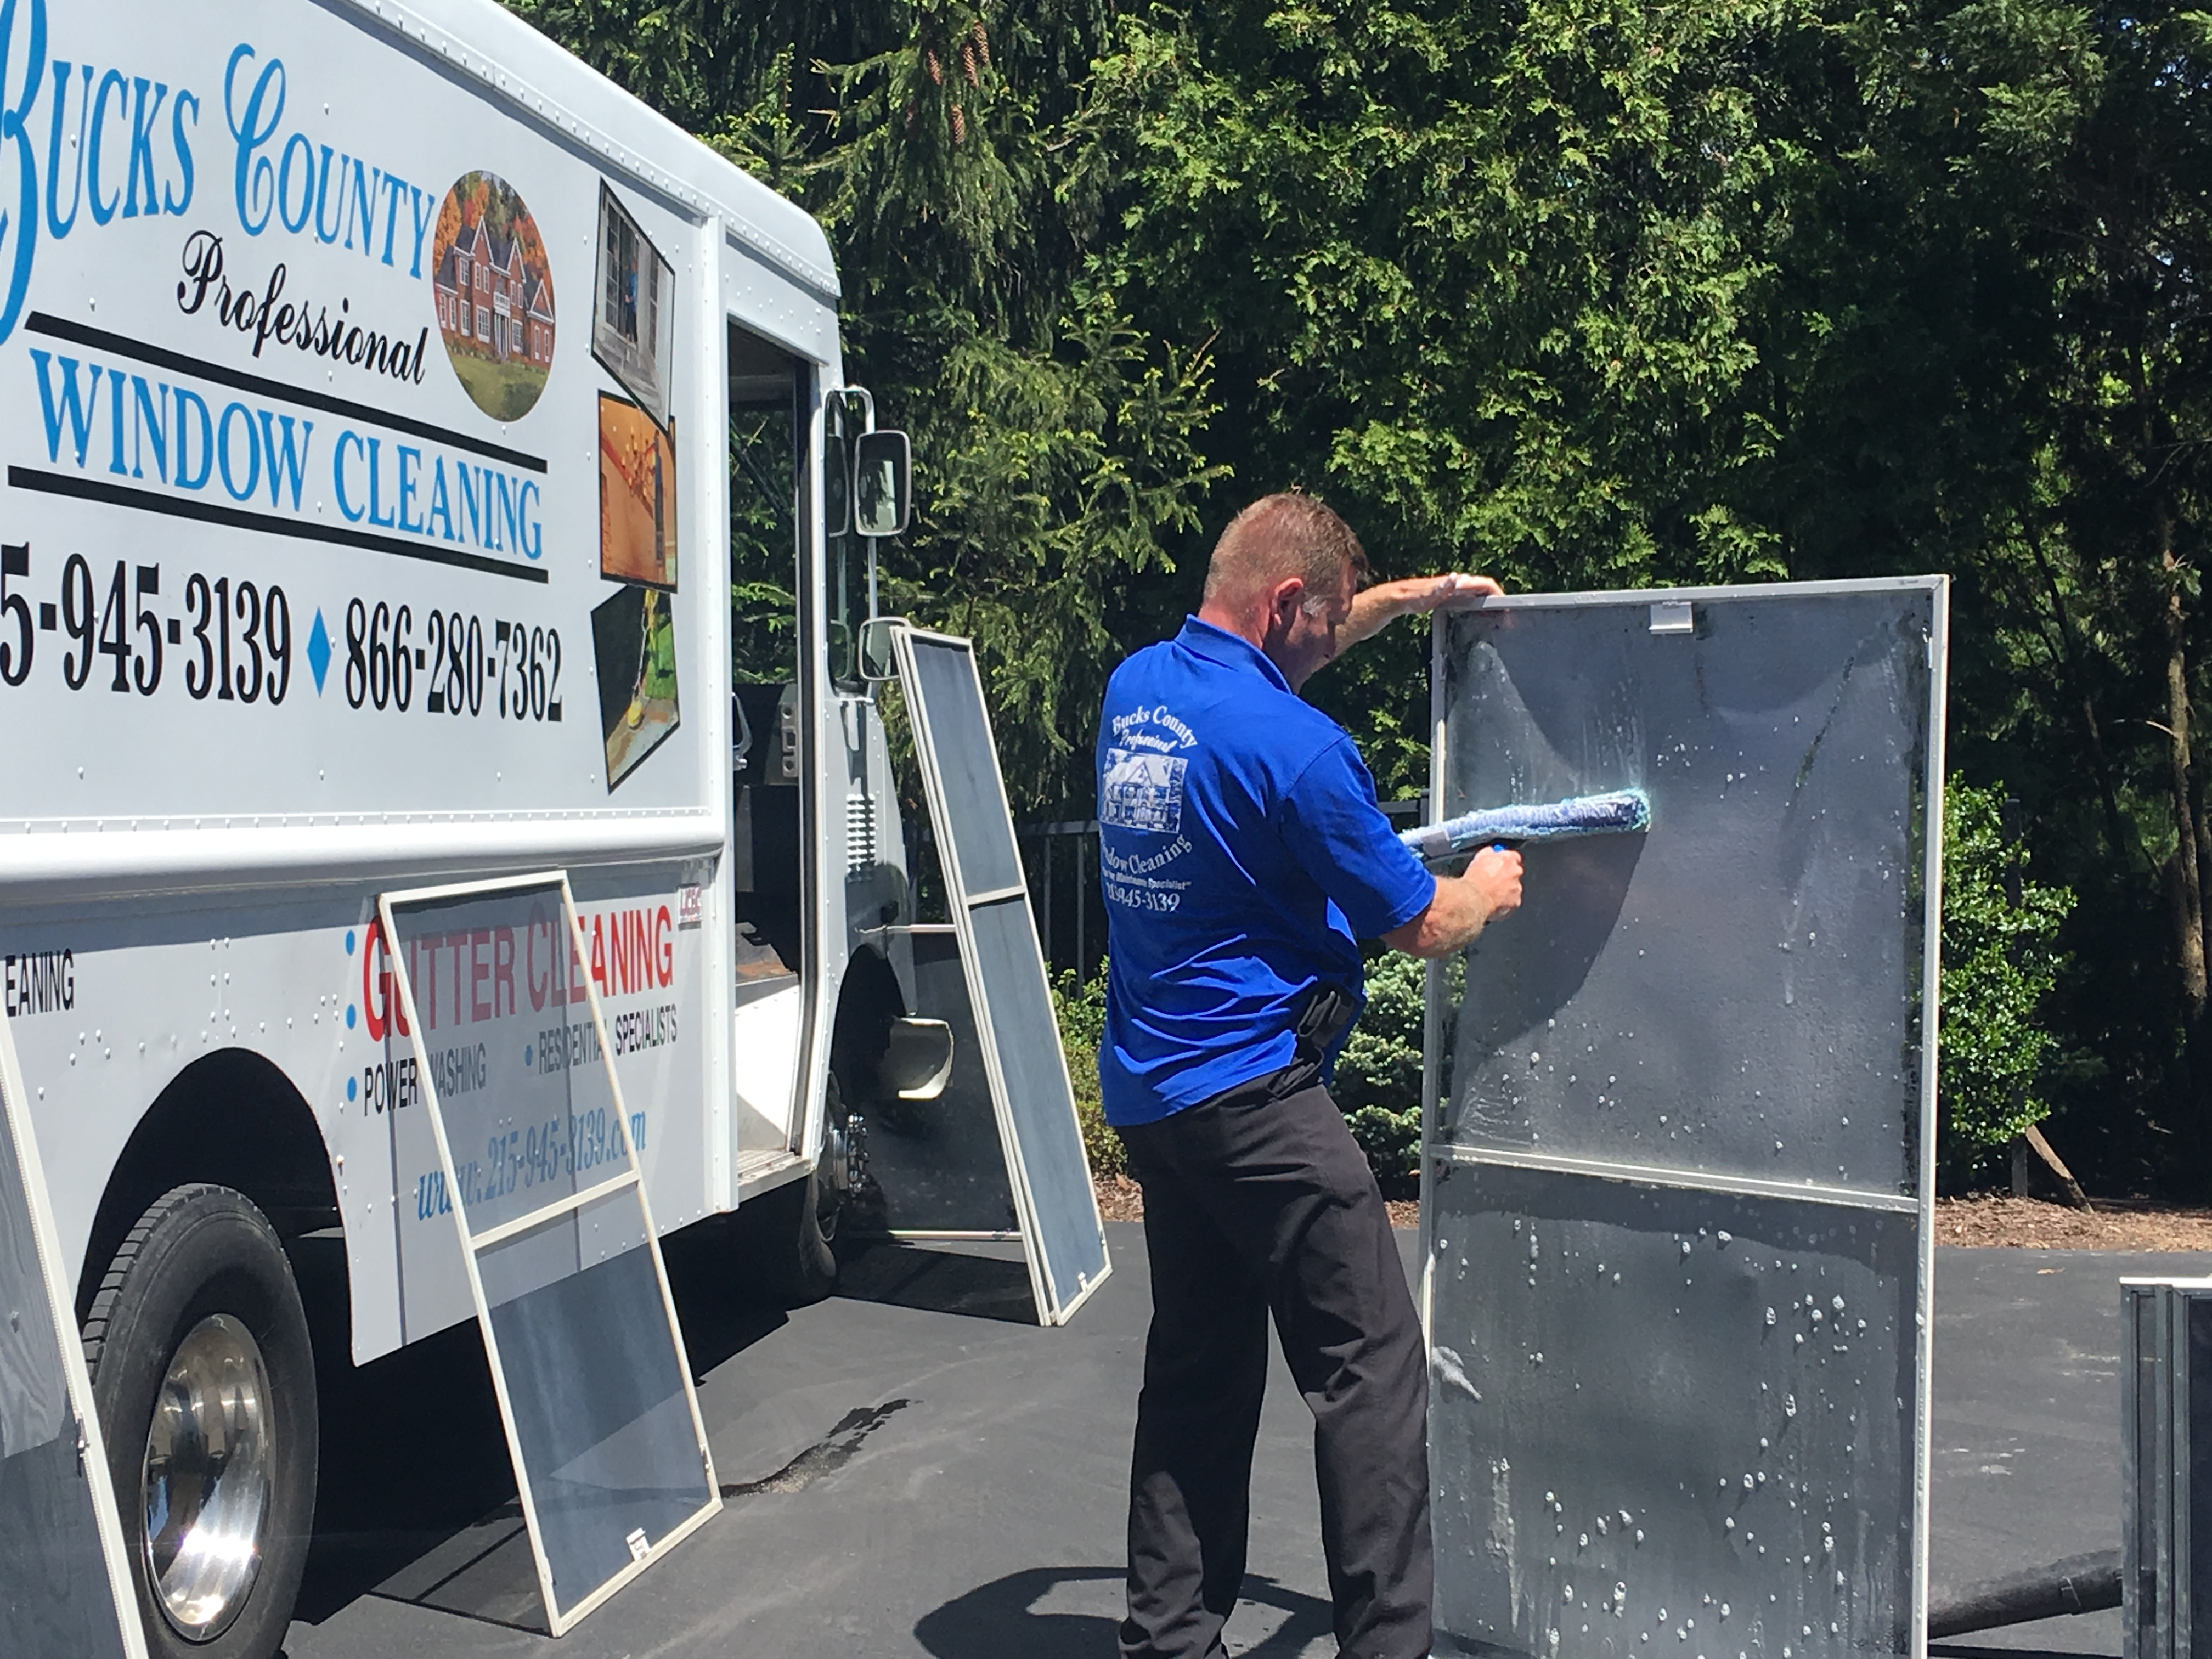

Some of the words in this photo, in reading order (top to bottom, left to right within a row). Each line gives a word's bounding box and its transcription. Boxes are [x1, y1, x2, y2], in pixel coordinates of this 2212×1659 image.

[224, 42, 436, 280] COUNTY
[177, 230, 429, 385] Professional
[29, 347, 314, 512] WINDOW
[334, 430, 543, 560] CLEANING
[345, 597, 563, 723] 866-280-7362
[1112, 705, 1150, 737] Bucks
[1153, 705, 1198, 749] County
[1128, 834, 1193, 874] Cleaning
[5, 948, 74, 1018] EANING
[364, 915, 515, 1042] GUTTER
[527, 900, 674, 1013] CLEANING
[364, 1057, 418, 1116] POWER
[538, 1018, 607, 1075] RESIDENTIA
[616, 1003, 678, 1057] SPECIALISTS
